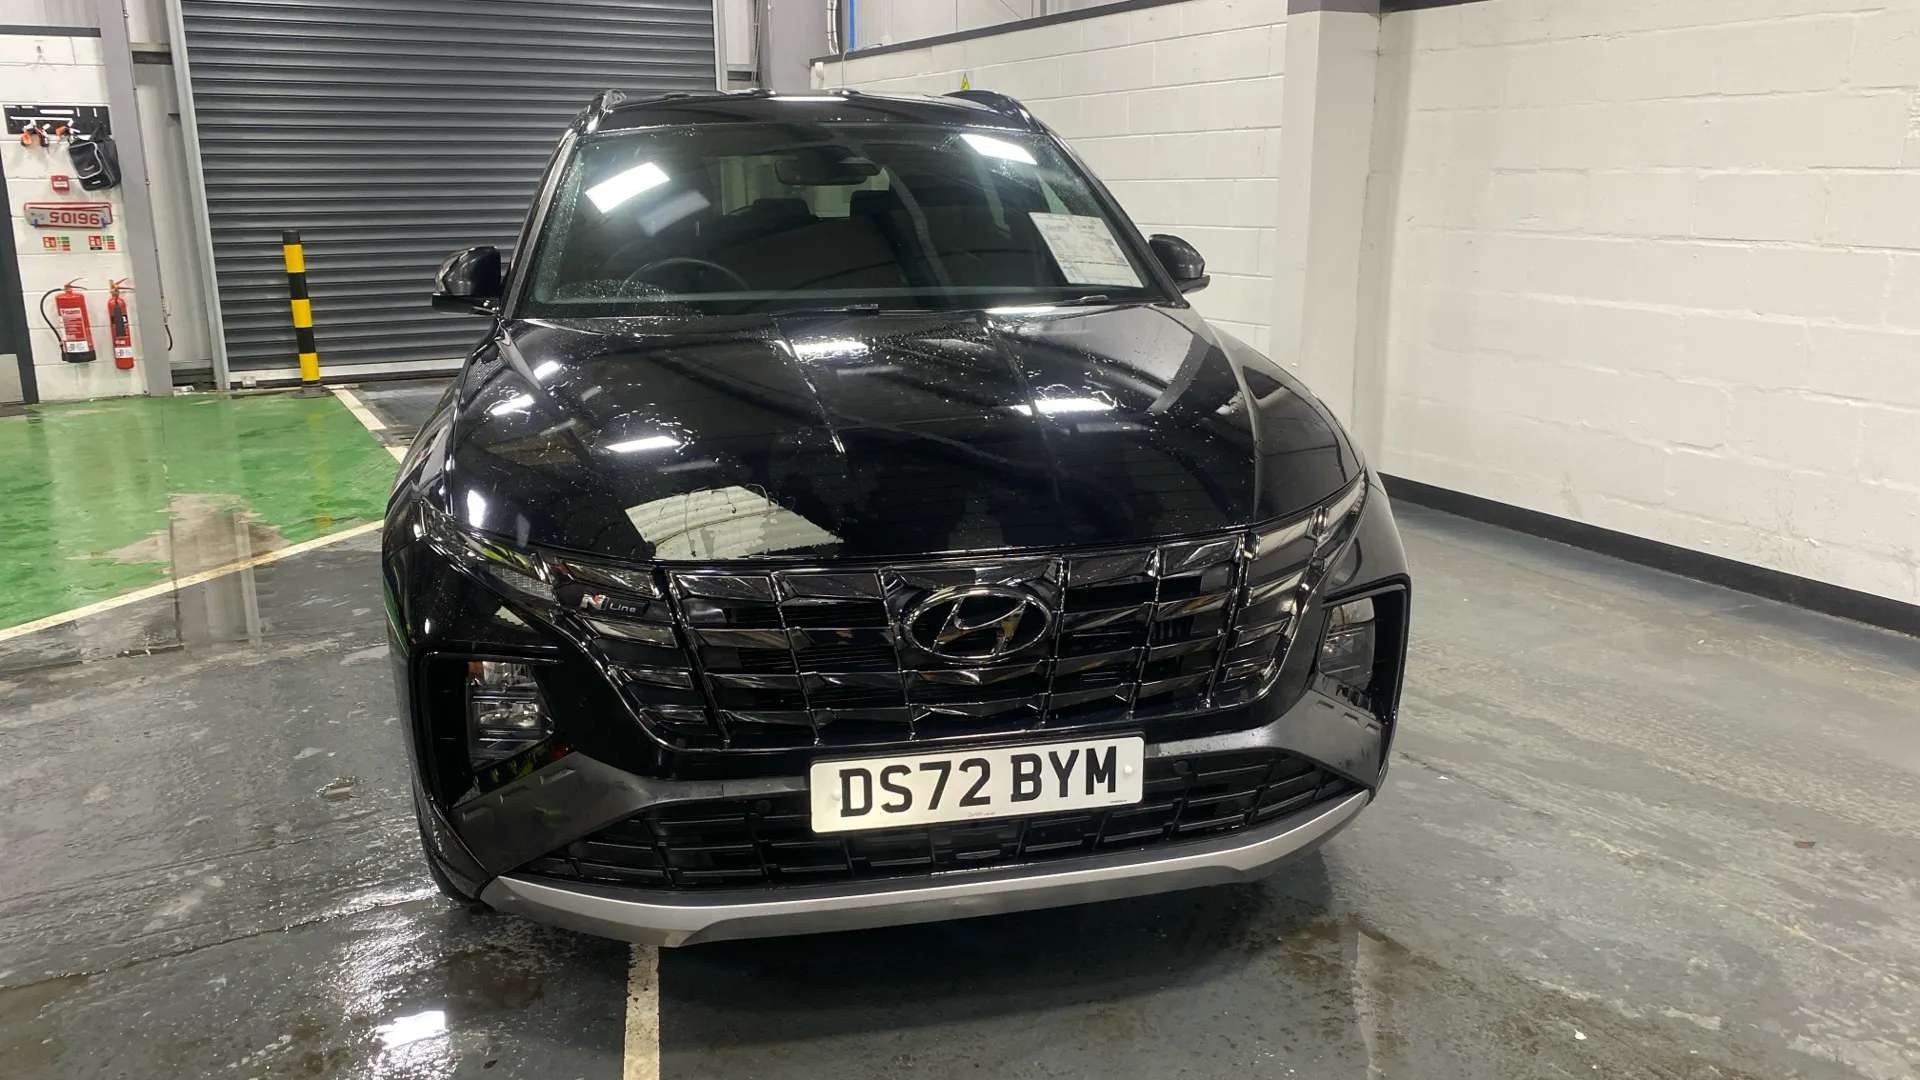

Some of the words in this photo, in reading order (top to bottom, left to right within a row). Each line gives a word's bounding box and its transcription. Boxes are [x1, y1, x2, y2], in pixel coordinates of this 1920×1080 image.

[610, 602, 637, 612] Line
[839, 757, 992, 818] DS72
[1010, 745, 1117, 803] BYM
